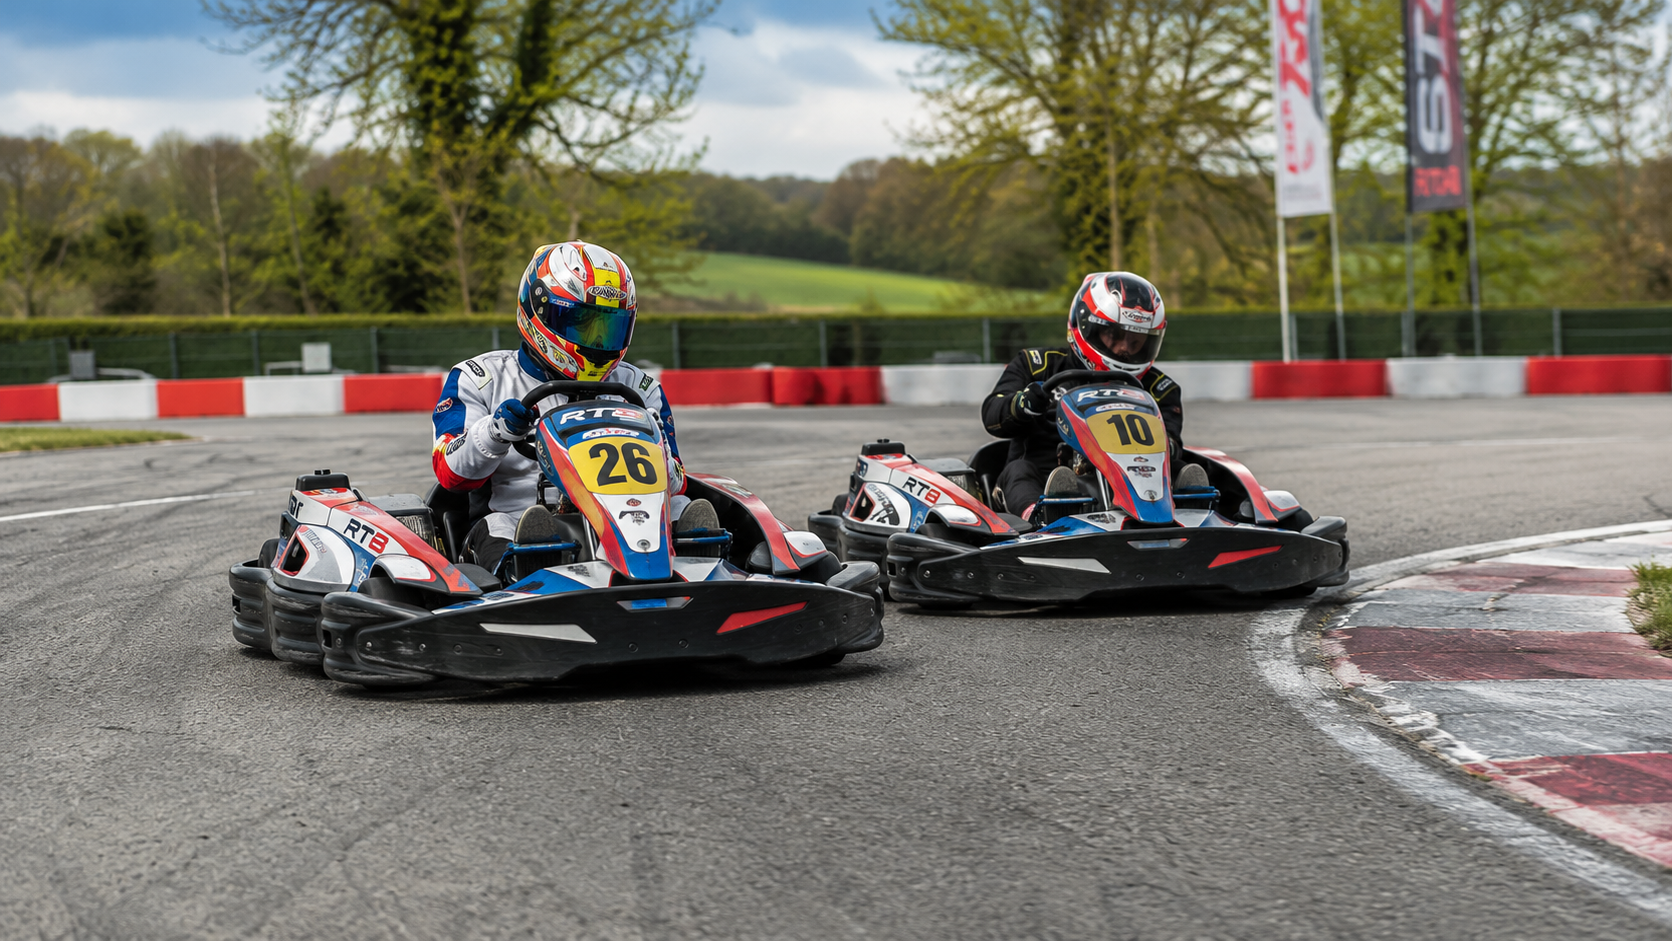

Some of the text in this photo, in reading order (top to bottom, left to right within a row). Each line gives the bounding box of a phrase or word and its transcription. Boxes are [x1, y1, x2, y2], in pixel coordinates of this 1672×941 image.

[1106, 414, 1154, 446] 10
[589, 442, 658, 487] 26
[902, 477, 941, 505] RT8
[344, 518, 389, 554] RT8
